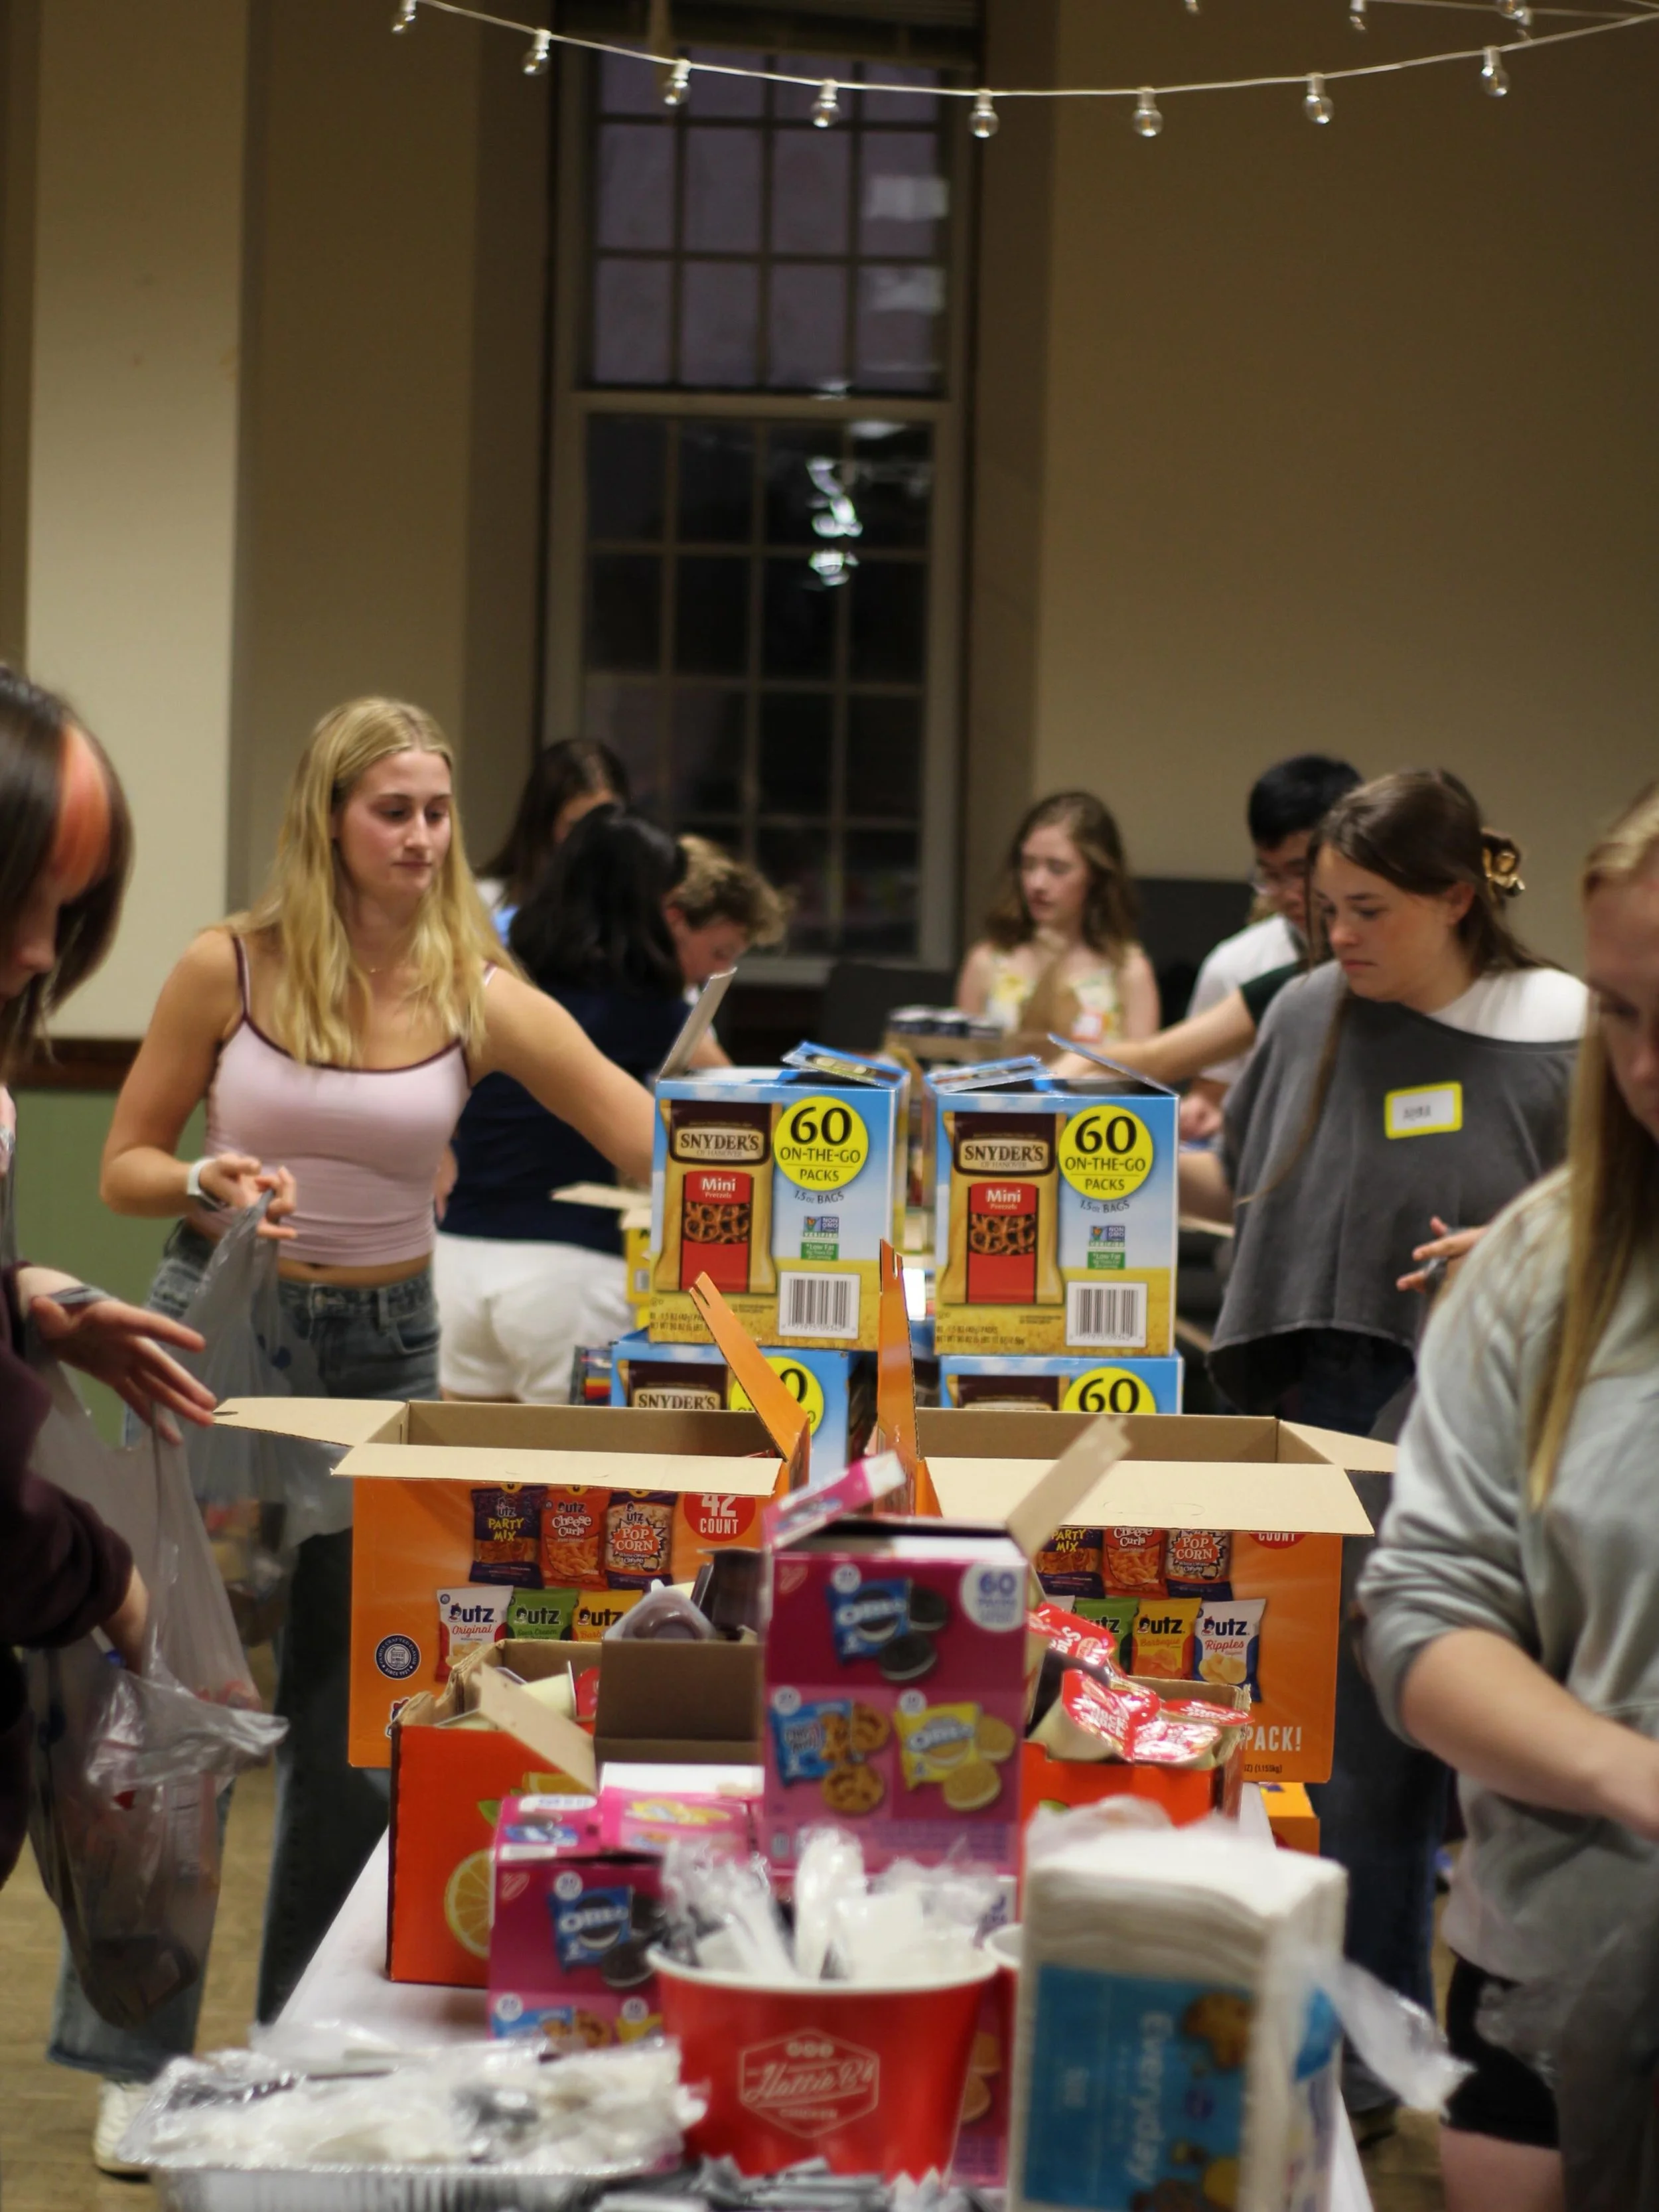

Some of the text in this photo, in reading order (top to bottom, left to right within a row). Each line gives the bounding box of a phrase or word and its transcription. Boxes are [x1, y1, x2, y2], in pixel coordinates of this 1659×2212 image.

[790, 1106, 852, 1147] 60
[681, 1134, 759, 1151] SNYDER'S
[1075, 1116, 1137, 1155] 60
[780, 1147, 861, 1163] ON-THE-GO
[965, 1145, 1044, 1162] SNYDER'S
[1065, 1157, 1146, 1172] ON-THE-GO
[800, 1168, 839, 1182] PACKS
[702, 1177, 736, 1192] Mini
[1085, 1178, 1125, 1191] PACKS
[817, 1191, 845, 1205] BAGS
[987, 1189, 1021, 1203] Mini
[1103, 1200, 1130, 1214] BAGS
[638, 1394, 715, 1410] SNYDER'S
[1078, 1378, 1140, 1414] 60
[701, 1493, 737, 1517] 42
[488, 1517, 525, 1530] PARTY
[552, 1515, 592, 1528] Cheese
[700, 1518, 739, 1534] COUNT
[494, 1530, 516, 1542] MIX
[558, 1526, 585, 1537] Curls
[622, 1527, 650, 1540] POP
[1052, 1528, 1087, 1541] PARTY
[616, 1540, 654, 1551] CORN
[1056, 1540, 1079, 1553] MIX
[1119, 1536, 1146, 1547] Curls
[1183, 1537, 1209, 1549] POP
[1177, 1548, 1213, 1560] CORN
[452, 1625, 493, 1638] Original
[1204, 1639, 1245, 1653] Ripples
[385, 1668, 398, 1676] SINCE
[1246, 1725, 1302, 1752] PACK!
